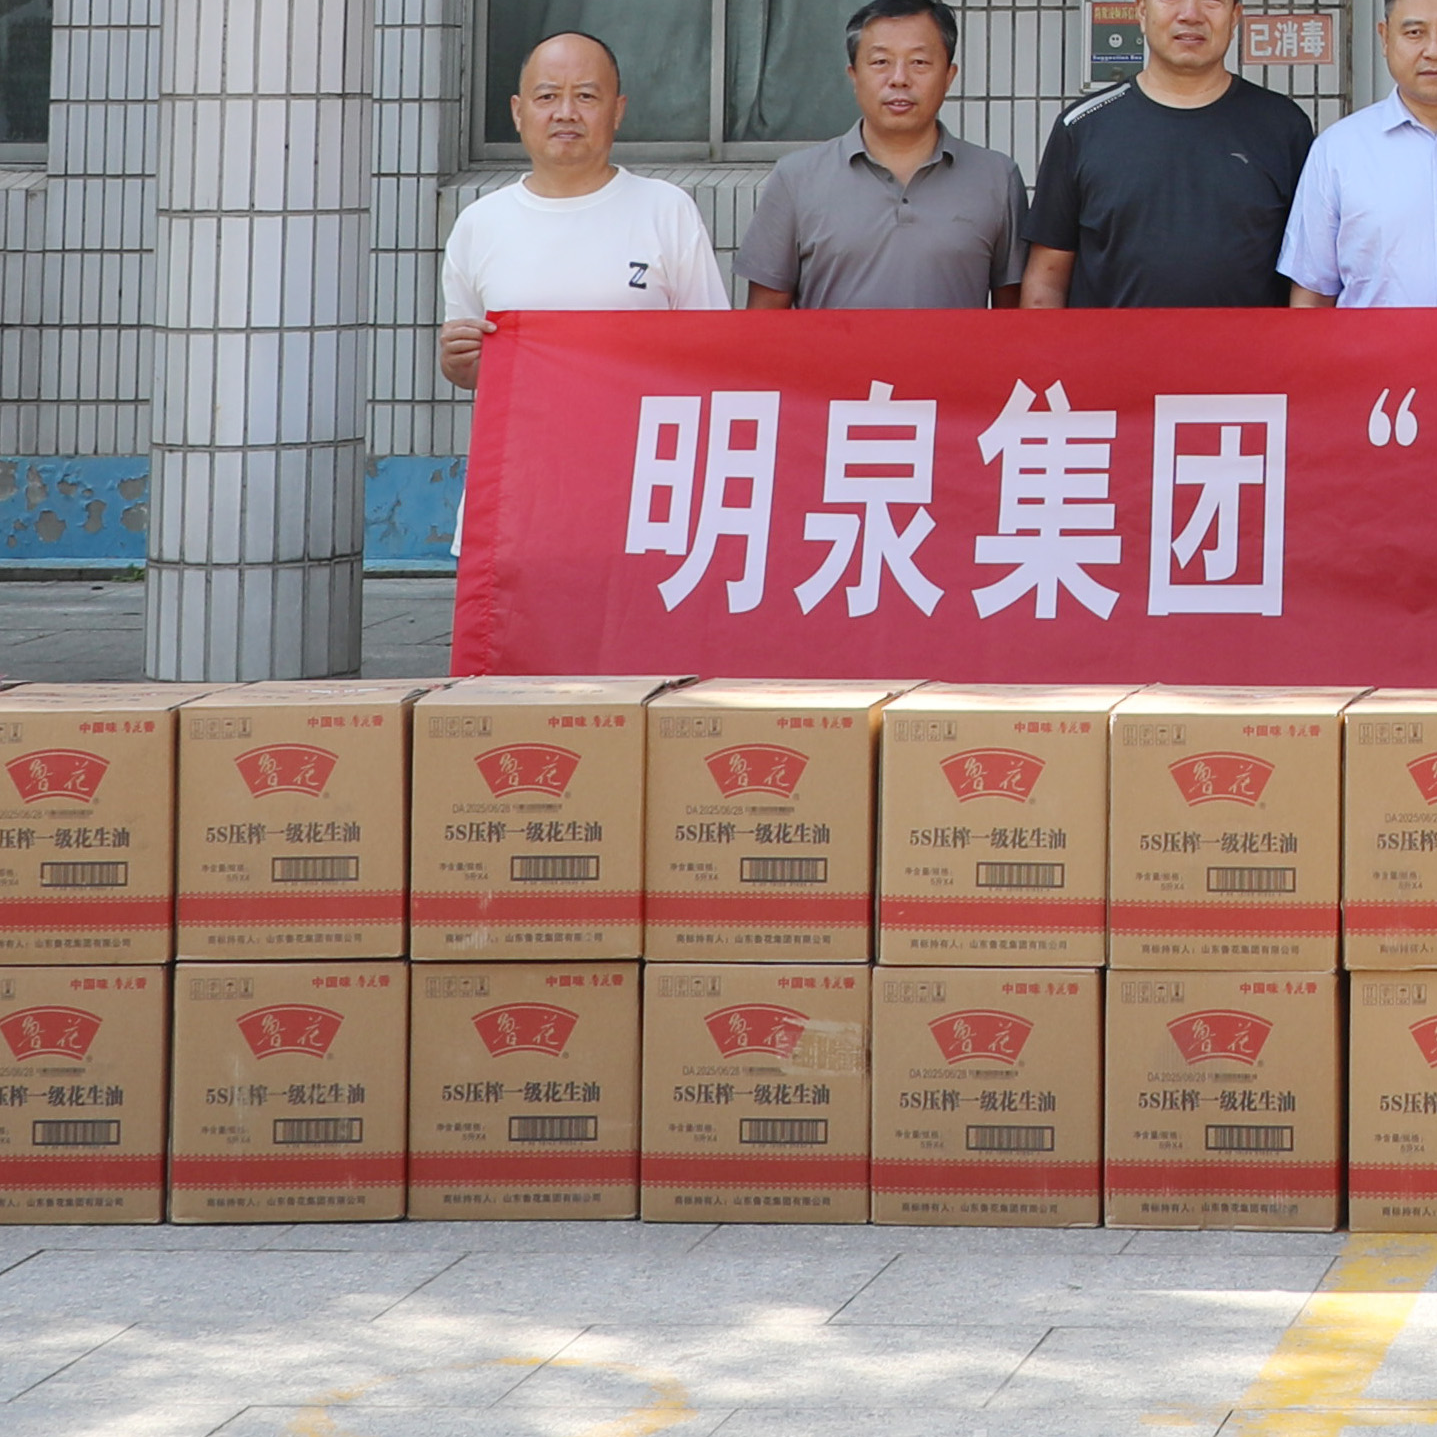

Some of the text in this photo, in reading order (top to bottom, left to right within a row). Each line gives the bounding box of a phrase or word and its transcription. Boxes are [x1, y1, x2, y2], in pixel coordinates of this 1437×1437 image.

[1249, 20, 1326, 59] 已消毒
[628, 260, 650, 290] Z
[79, 722, 117, 733] 中国味
[307, 716, 346, 727] 中国味
[548, 716, 587, 727] 中国味
[776, 717, 815, 728] 中国味
[1014, 722, 1052, 733] 中国味
[1243, 725, 1282, 736] 中国味
[205, 823, 362, 844] 5S压榨一级花生油
[443, 822, 603, 843] 5S压榨一级花生油
[674, 823, 831, 844] 5S压榨一级花生油
[909, 828, 1067, 849] 5S压榨一级花生油
[1138, 832, 1298, 853] 5S压榨一级花生油
[69, 978, 109, 990] 中国味
[312, 976, 352, 988] 中国味
[546, 975, 585, 986] 中国味
[778, 977, 816, 988] 中国味
[1002, 983, 1041, 994] 中国味
[1239, 982, 1279, 994] 中国味
[441, 1082, 601, 1103] 5S压榨一级花生油
[672, 1084, 830, 1105] 5S压榨一级花生油
[898, 1090, 1056, 1111] 5S压榨一级花生油
[1137, 1090, 1297, 1111] 5S压榨一级花生油
